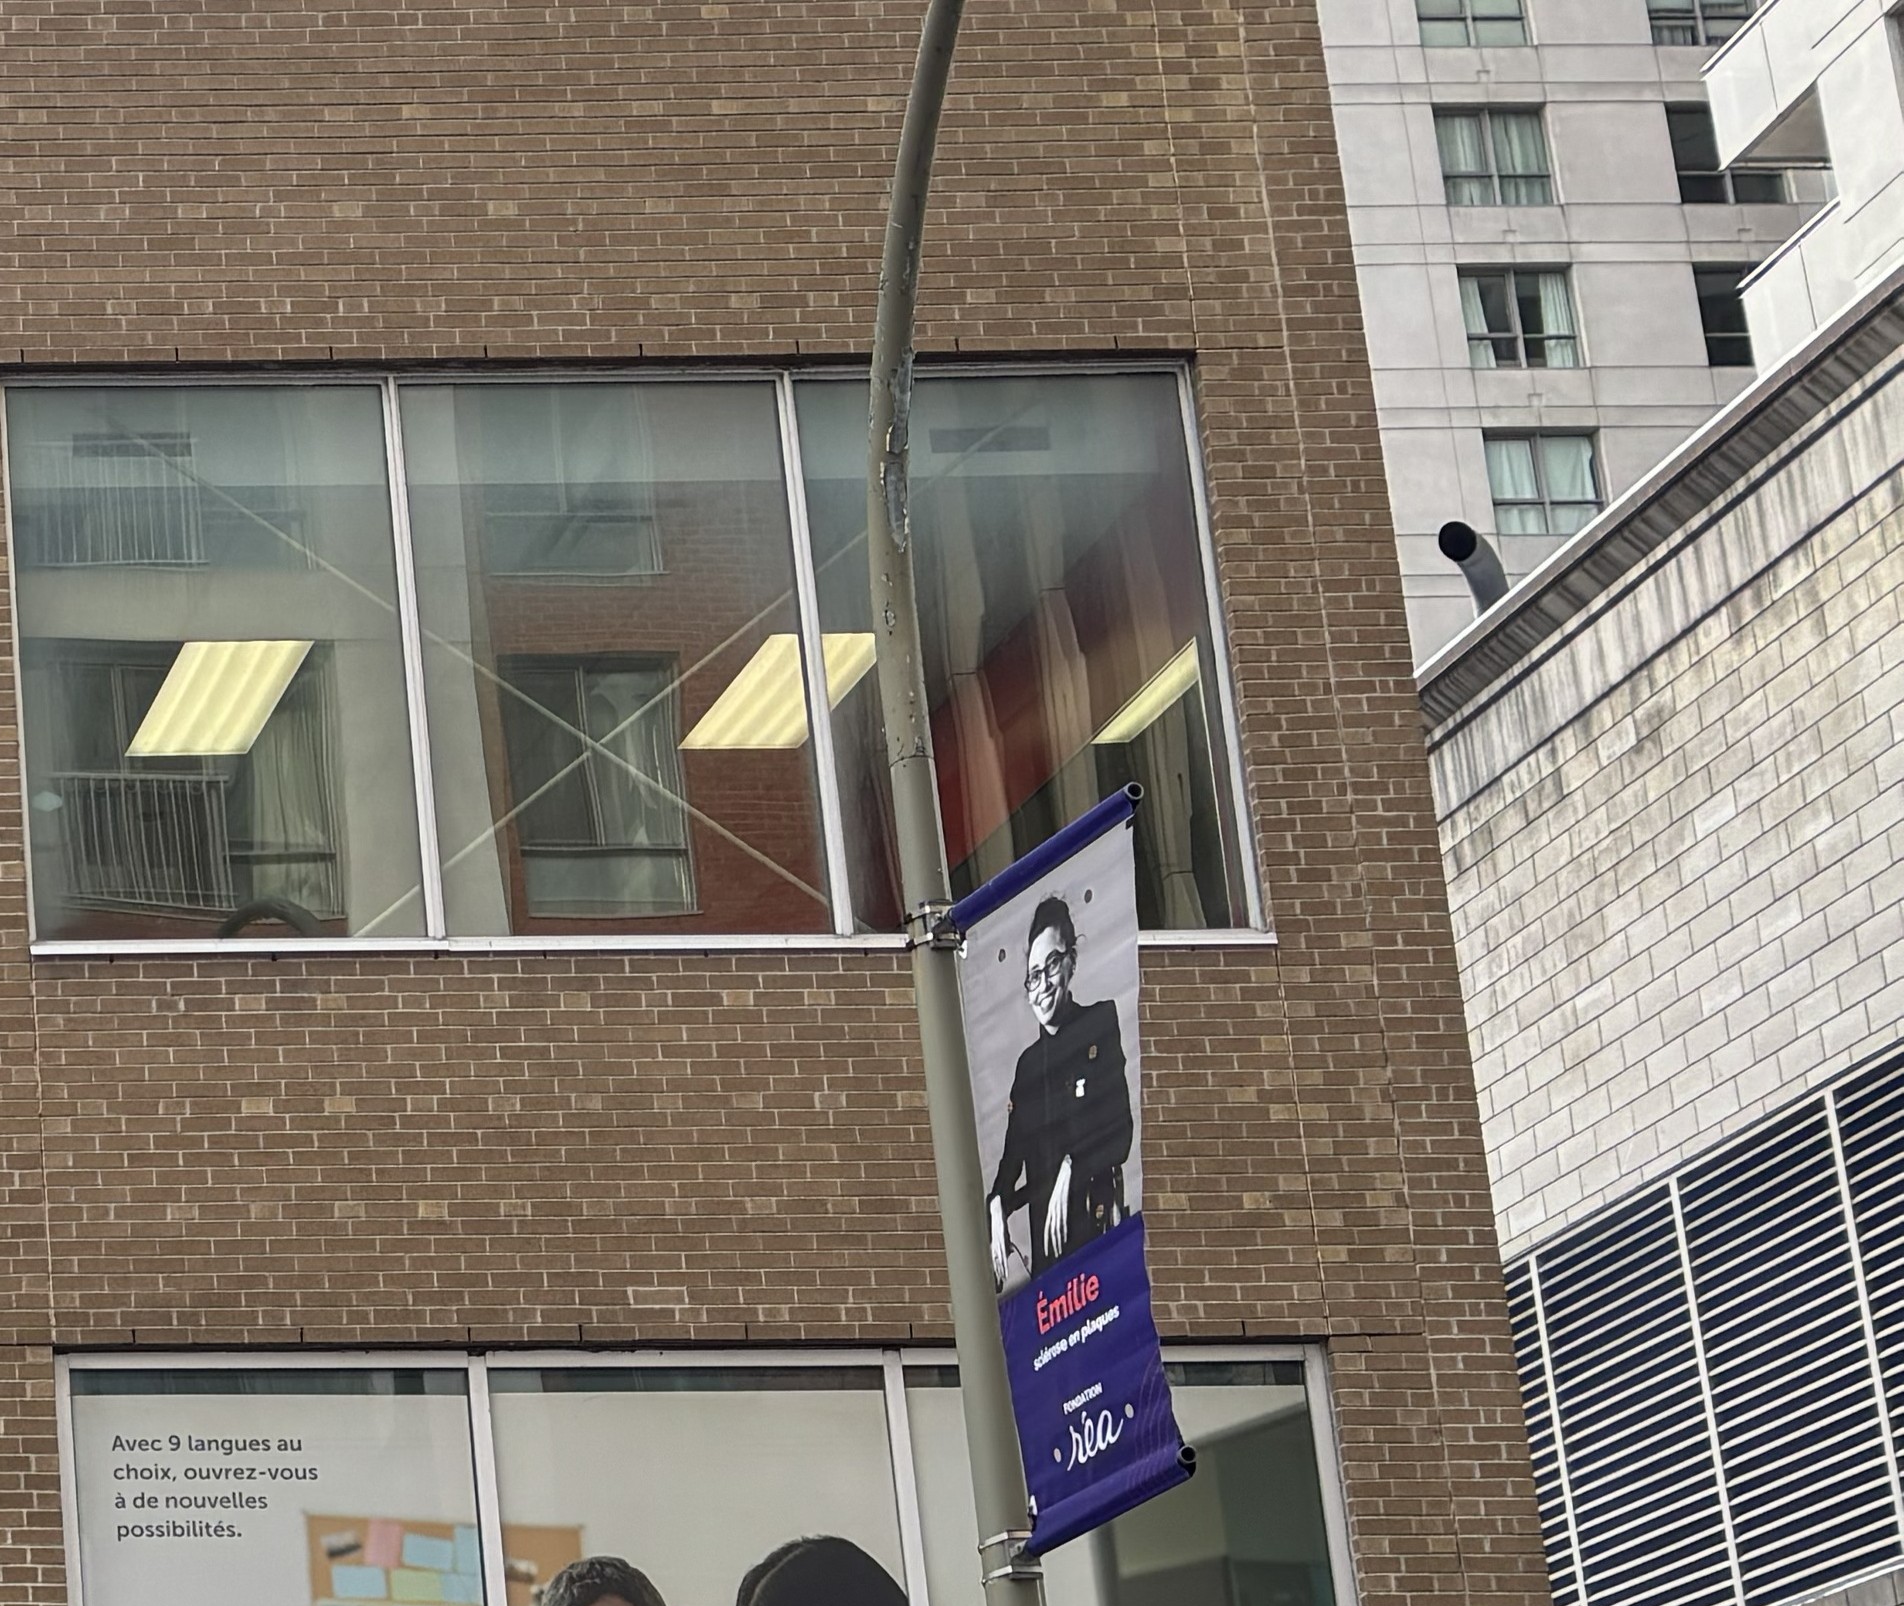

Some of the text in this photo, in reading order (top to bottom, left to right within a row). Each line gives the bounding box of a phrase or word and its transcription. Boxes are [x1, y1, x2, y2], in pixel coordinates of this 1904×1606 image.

[1036, 1273, 1100, 1335] Émilie
[1033, 1305, 1120, 1371] sclérose en plaques
[1062, 1382, 1103, 1415] FONDATION
[111, 1434, 303, 1456] Avec 9 langues au
[1067, 1411, 1124, 1471] réa
[113, 1463, 319, 1482] choix, ouvrez-vous
[114, 1491, 268, 1509] à de nouvelles
[116, 1520, 242, 1542] possibilités.
